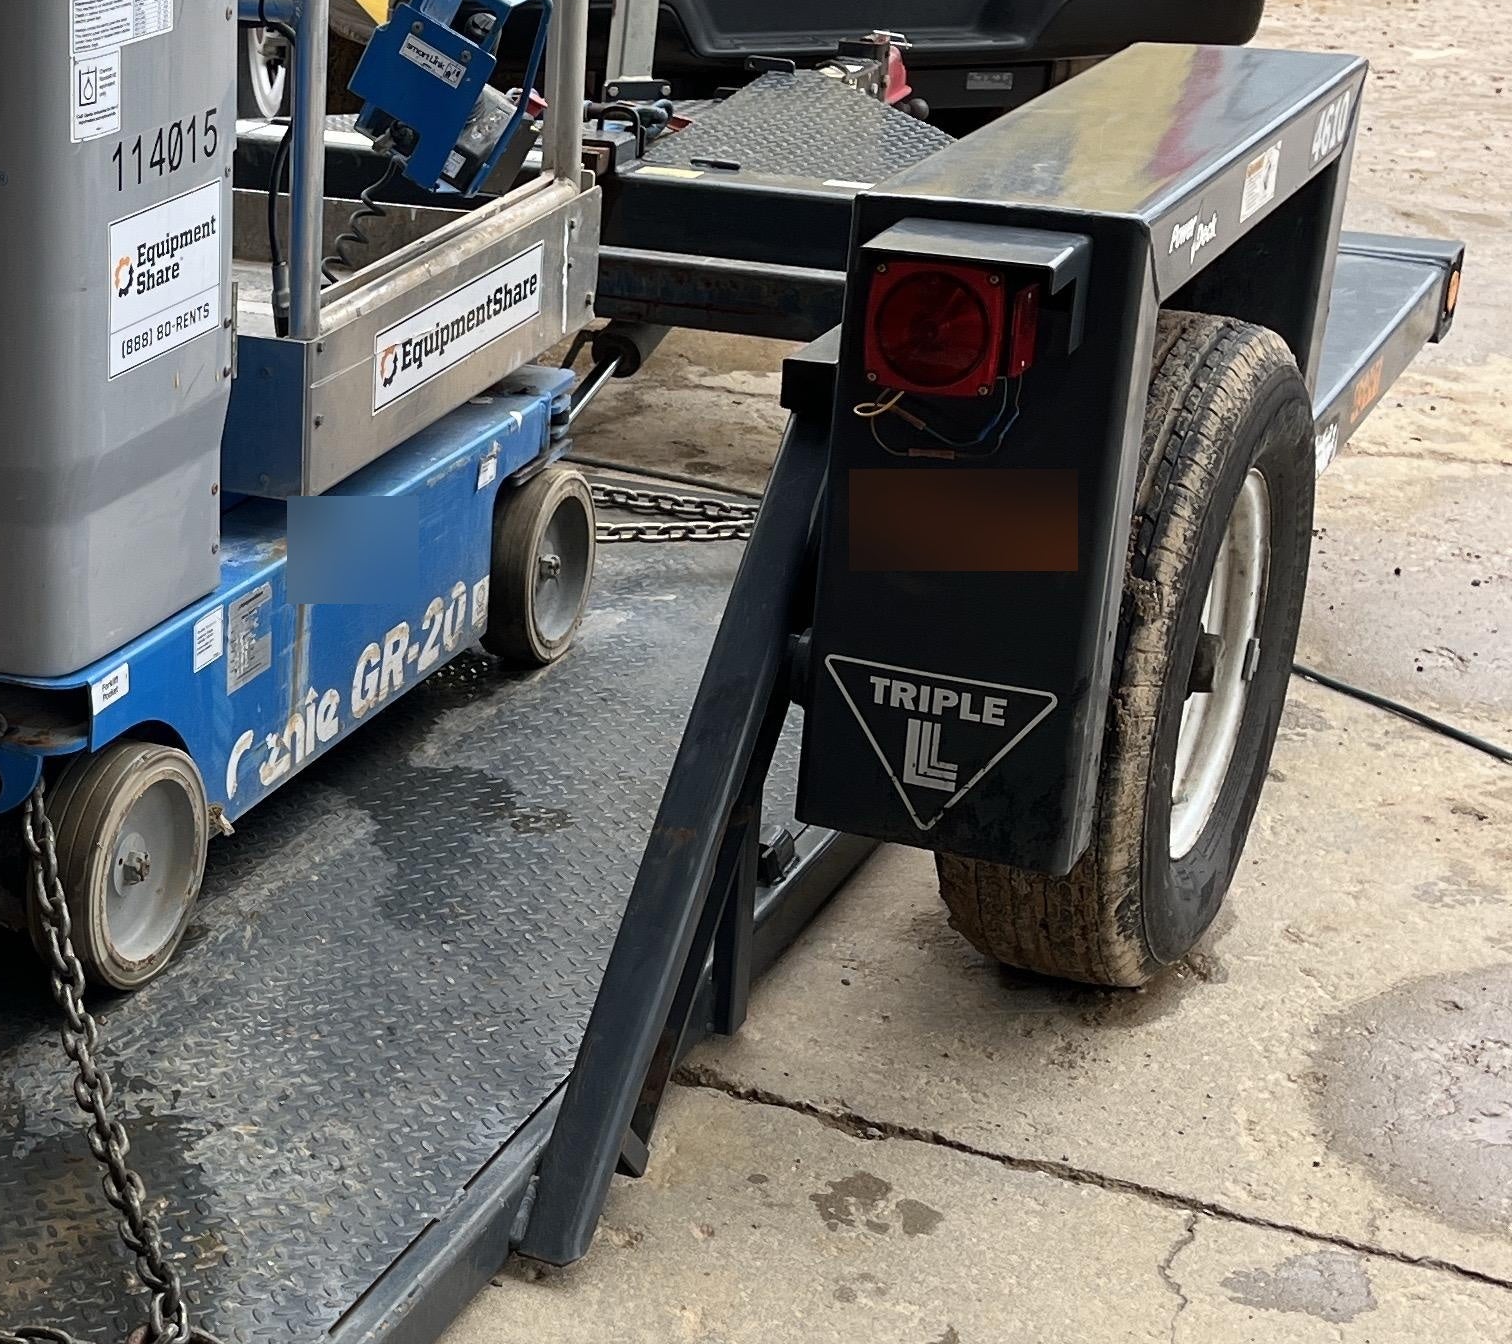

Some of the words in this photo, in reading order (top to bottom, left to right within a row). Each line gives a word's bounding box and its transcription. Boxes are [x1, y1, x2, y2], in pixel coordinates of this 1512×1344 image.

[136, 214, 217, 268] Equipment
[136, 260, 181, 296] Share
[121, 327, 153, 359] (888)
[156, 302, 211, 340] 80-RENTS
[400, 273, 538, 372] EquipmentShare
[869, 675, 1008, 727] TRIPLE
